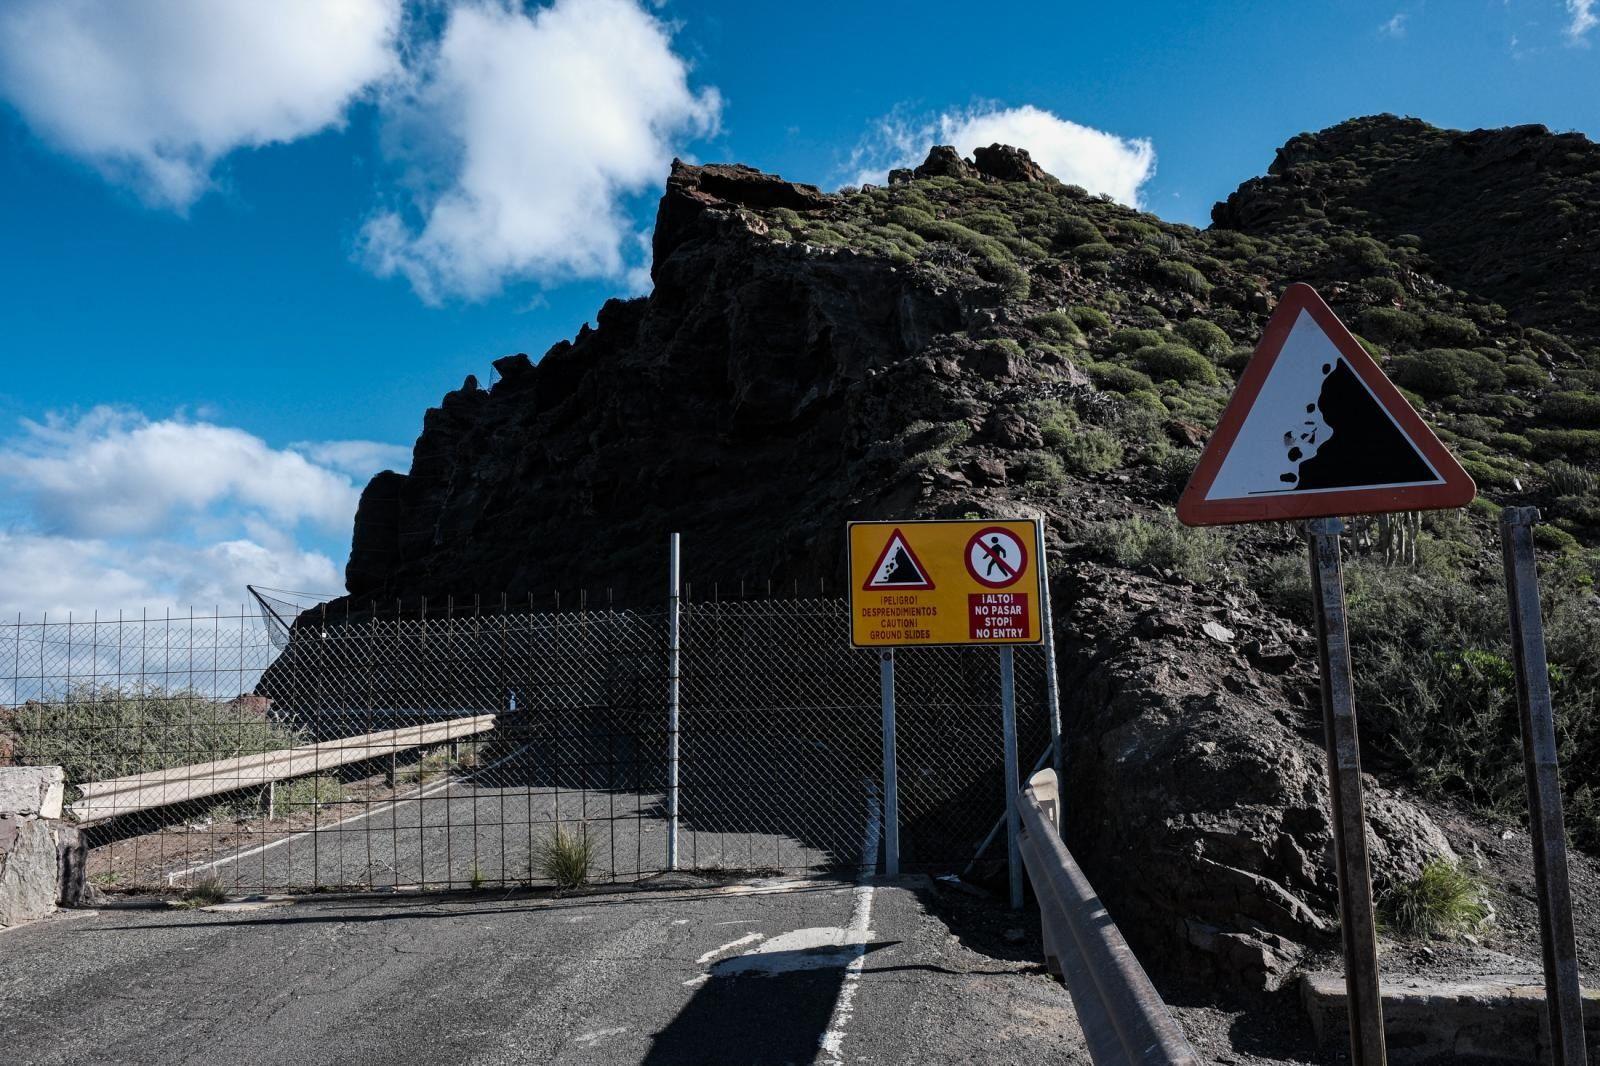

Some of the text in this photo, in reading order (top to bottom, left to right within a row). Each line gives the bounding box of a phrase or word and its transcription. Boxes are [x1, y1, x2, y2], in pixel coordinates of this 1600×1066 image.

[862, 607, 937, 616] DESPRENDIMIENTOS
[975, 606, 1022, 615] NO PASAR
[870, 630, 930, 640] GROUND SLIDES
[976, 628, 1023, 638] NO ENTRY
